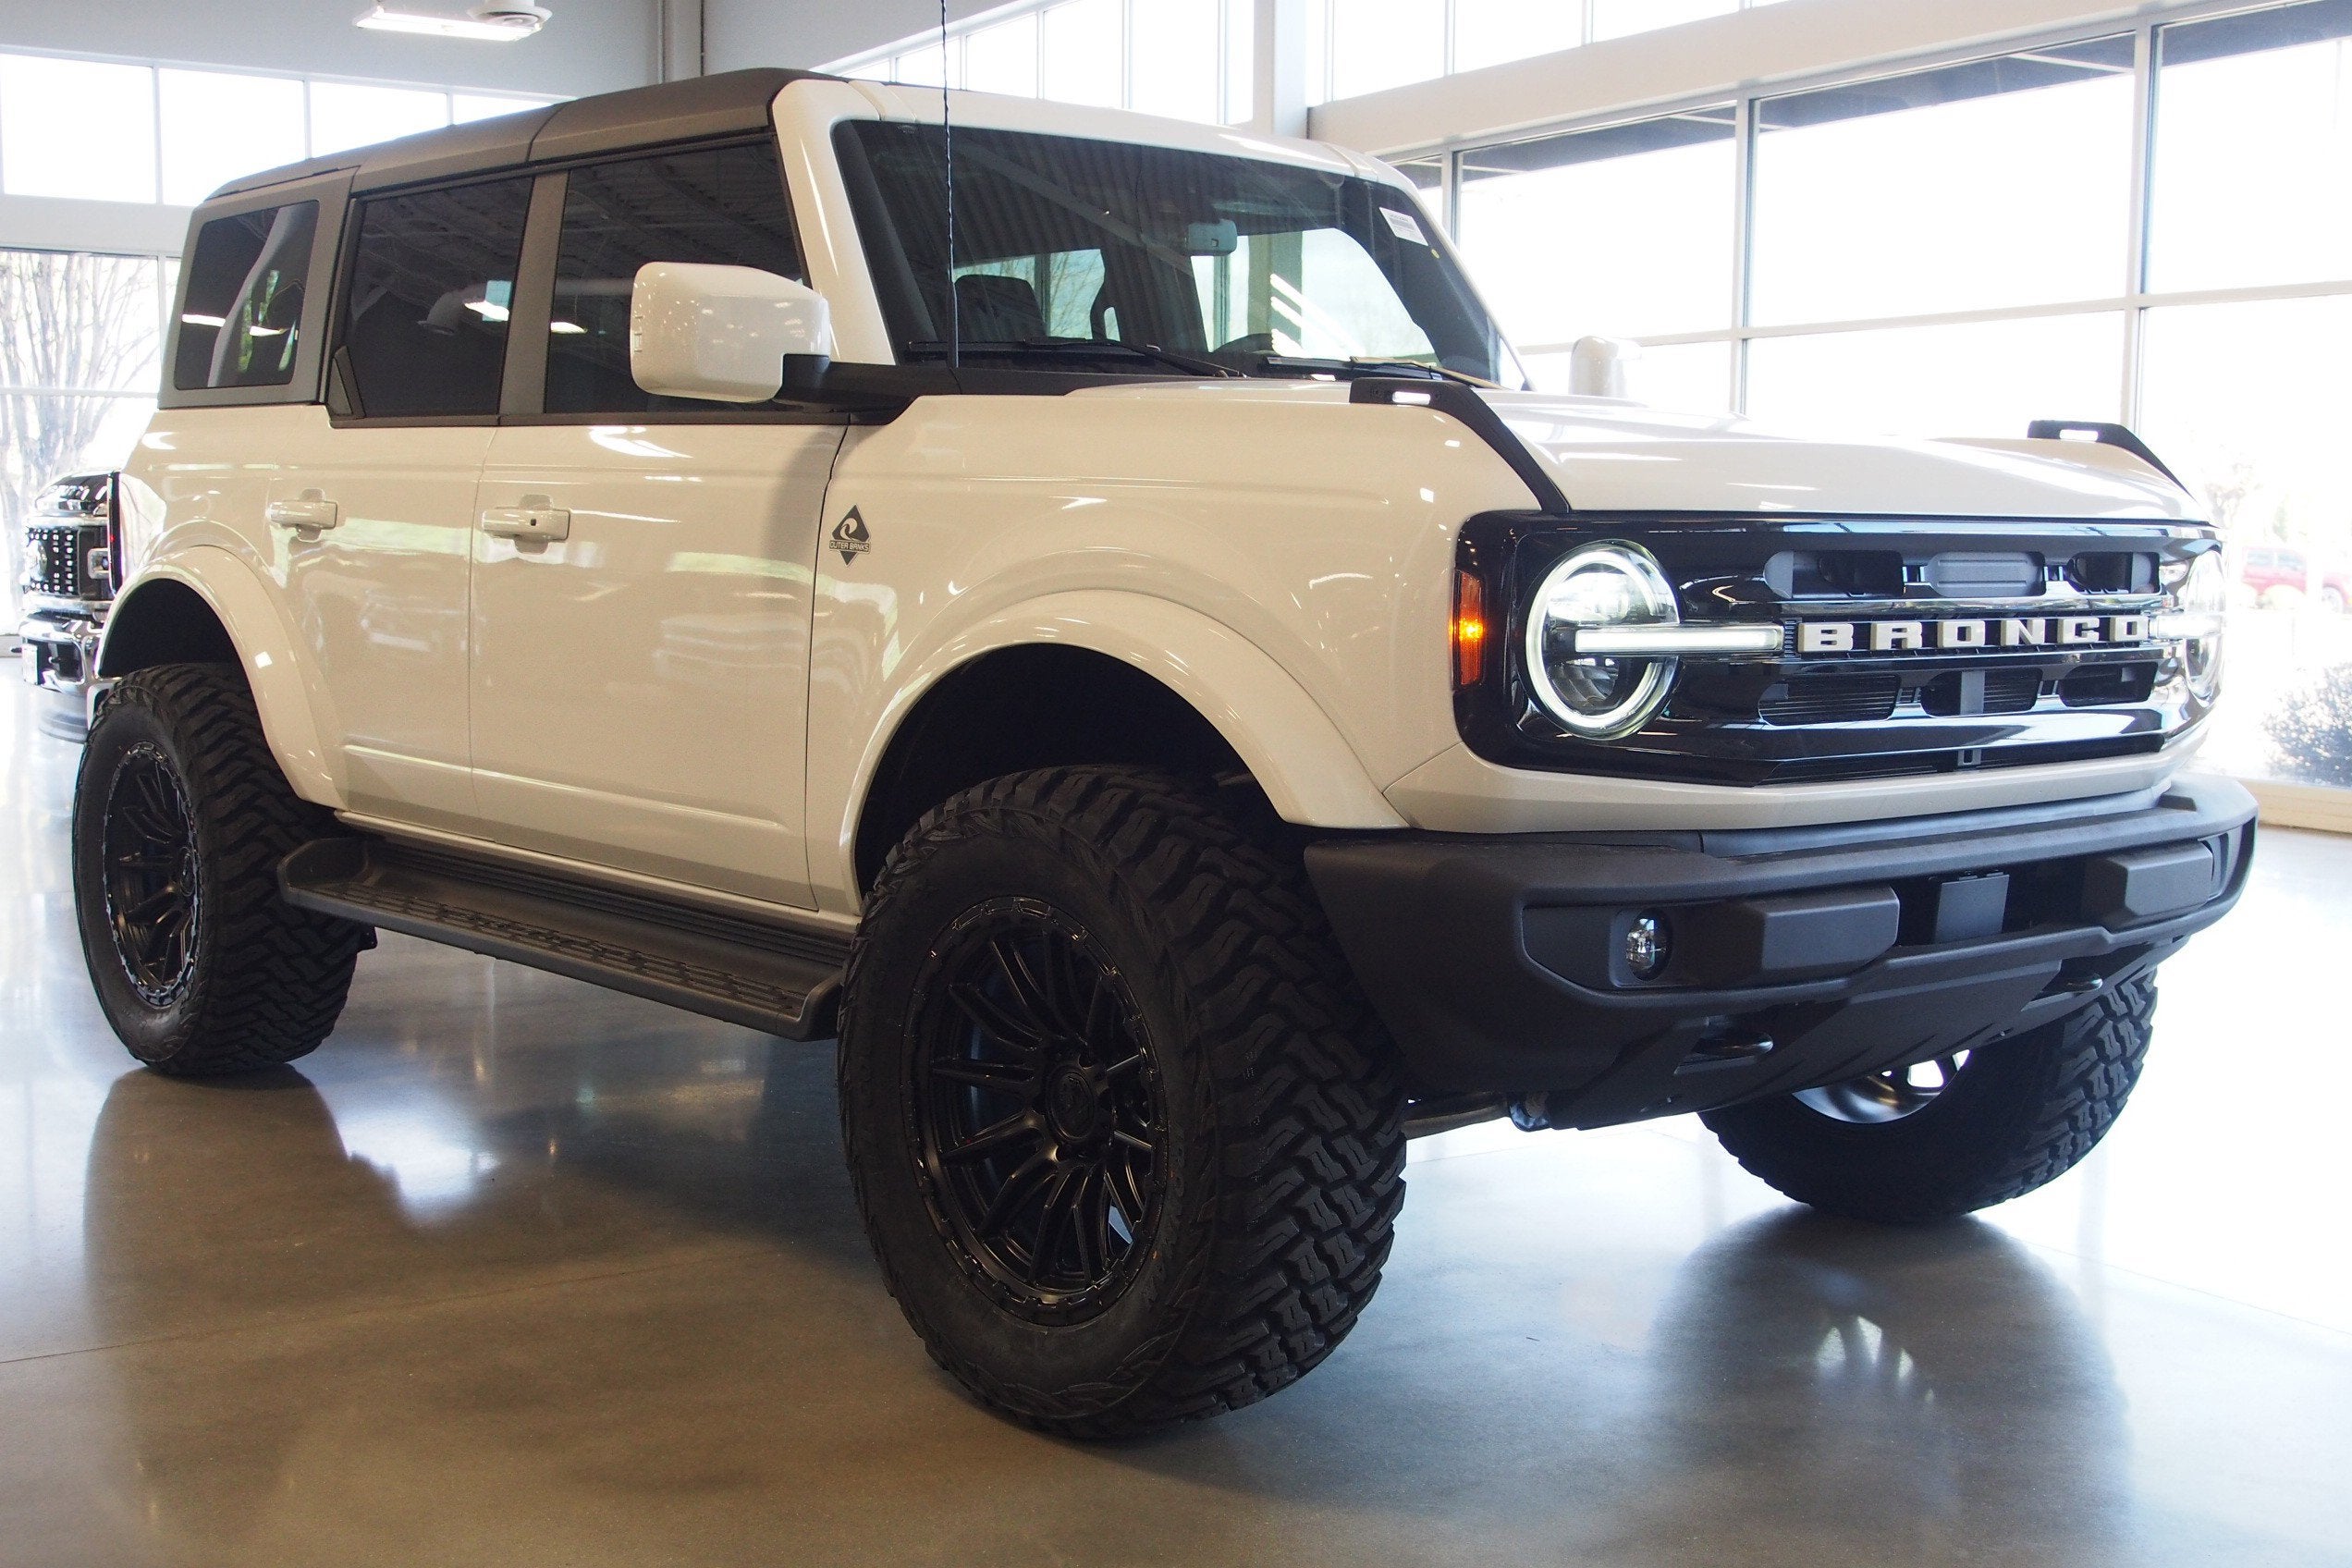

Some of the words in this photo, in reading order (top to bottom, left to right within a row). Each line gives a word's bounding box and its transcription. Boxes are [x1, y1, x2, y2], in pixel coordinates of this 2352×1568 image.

[830, 541, 849, 550] OUTER
[850, 542, 869, 552] BANKS
[1798, 616, 2148, 653] BRONCO
